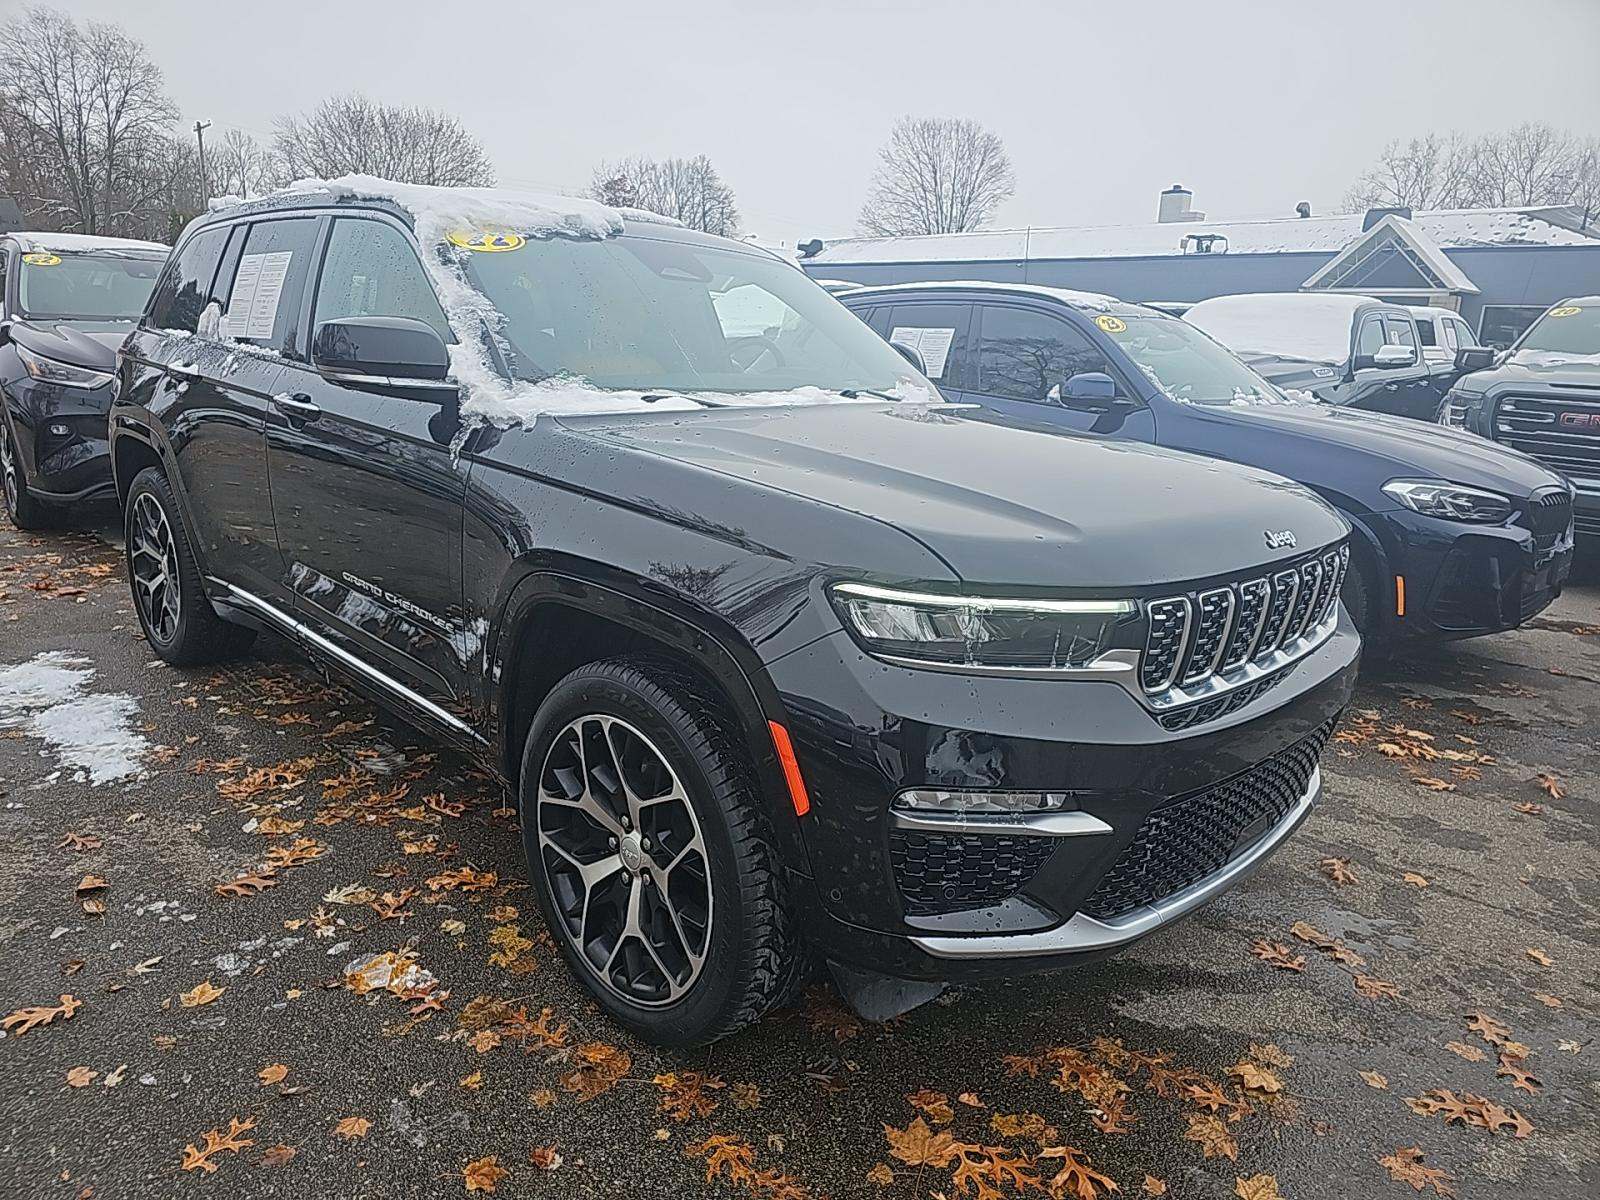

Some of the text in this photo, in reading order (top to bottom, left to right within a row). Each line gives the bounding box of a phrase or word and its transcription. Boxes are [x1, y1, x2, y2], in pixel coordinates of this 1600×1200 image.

[1101, 317, 1121, 330] 23
[1264, 530, 1297, 549] Jeep
[342, 571, 456, 635] GRAND CHEROKEE
